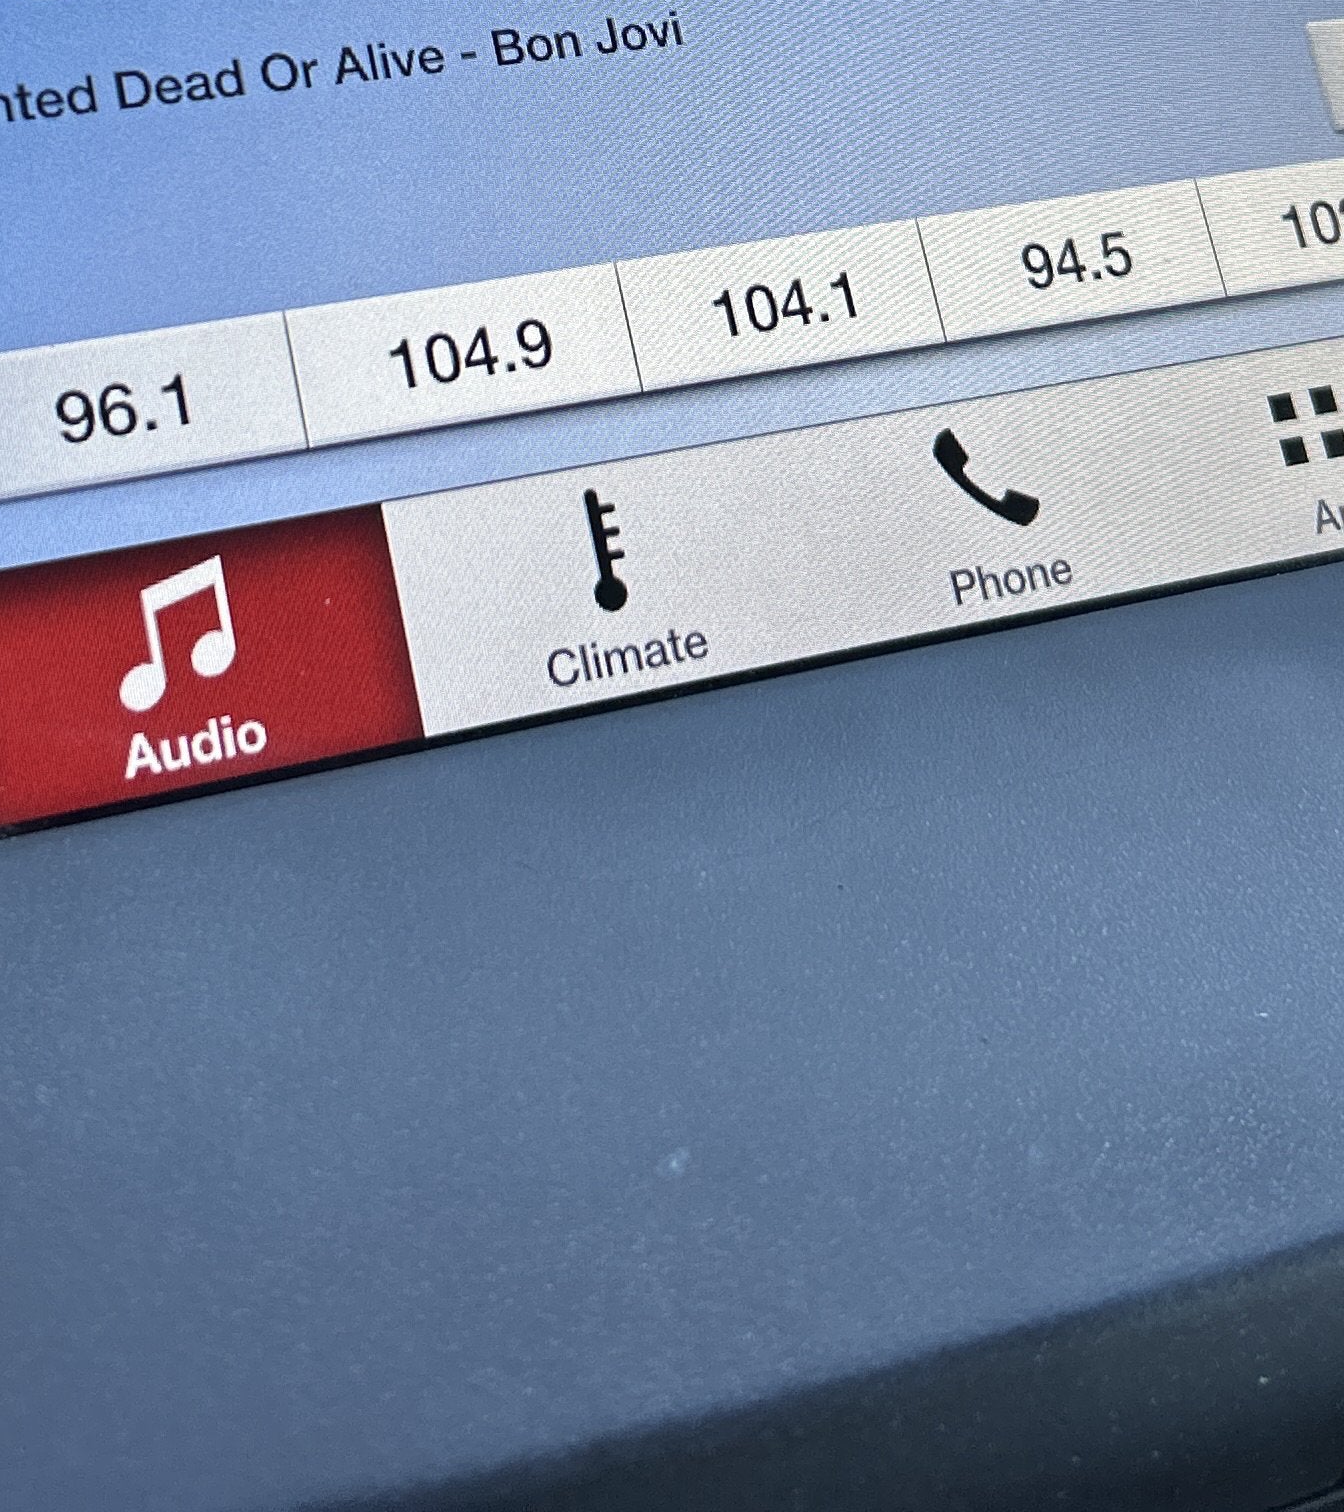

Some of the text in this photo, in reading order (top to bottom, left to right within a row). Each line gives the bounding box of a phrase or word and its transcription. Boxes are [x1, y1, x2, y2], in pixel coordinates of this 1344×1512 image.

[114, 58, 245, 110] Dead
[260, 53, 318, 92] Or
[335, 42, 444, 85] Alive
[491, 28, 582, 66] Bon
[596, 10, 683, 55] Jovi
[1021, 231, 1133, 290] 94.5
[713, 272, 857, 337] 104.1
[390, 319, 552, 389] 104.9
[55, 374, 190, 444] 96.1
[949, 554, 1074, 606] Phone
[546, 627, 709, 690] Climate
[125, 715, 267, 779] Audio
